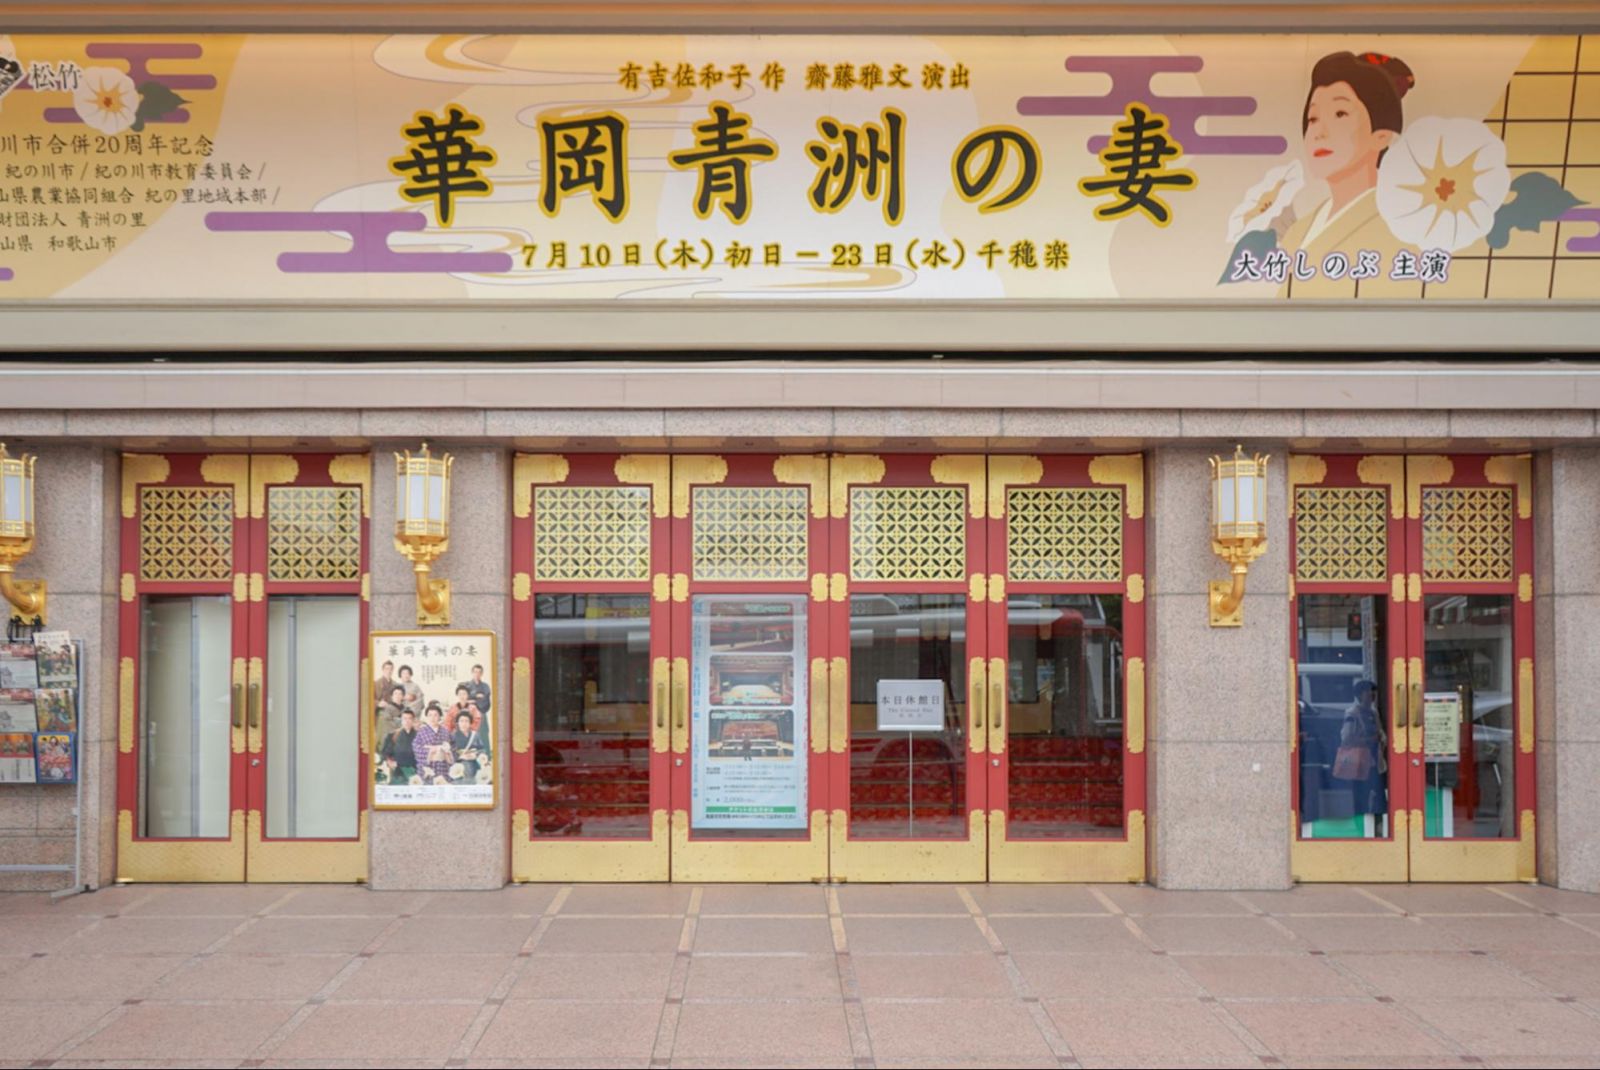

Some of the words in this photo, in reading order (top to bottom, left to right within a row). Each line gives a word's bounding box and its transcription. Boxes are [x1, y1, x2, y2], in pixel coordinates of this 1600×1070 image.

[32, 63, 81, 90] 松竹
[618, 61, 751, 92] 有吉佐和子
[759, 61, 786, 92] 作
[921, 61, 970, 91] 演出
[0, 134, 214, 157] 川市合併20周年記念
[390, 102, 1198, 228] 華岡青洲の妻
[77, 211, 147, 229] 青洲の里
[48, 234, 118, 252] 和歌山市
[1233, 251, 1379, 281] 大竹しのぶ
[1391, 251, 1449, 281] 主演
